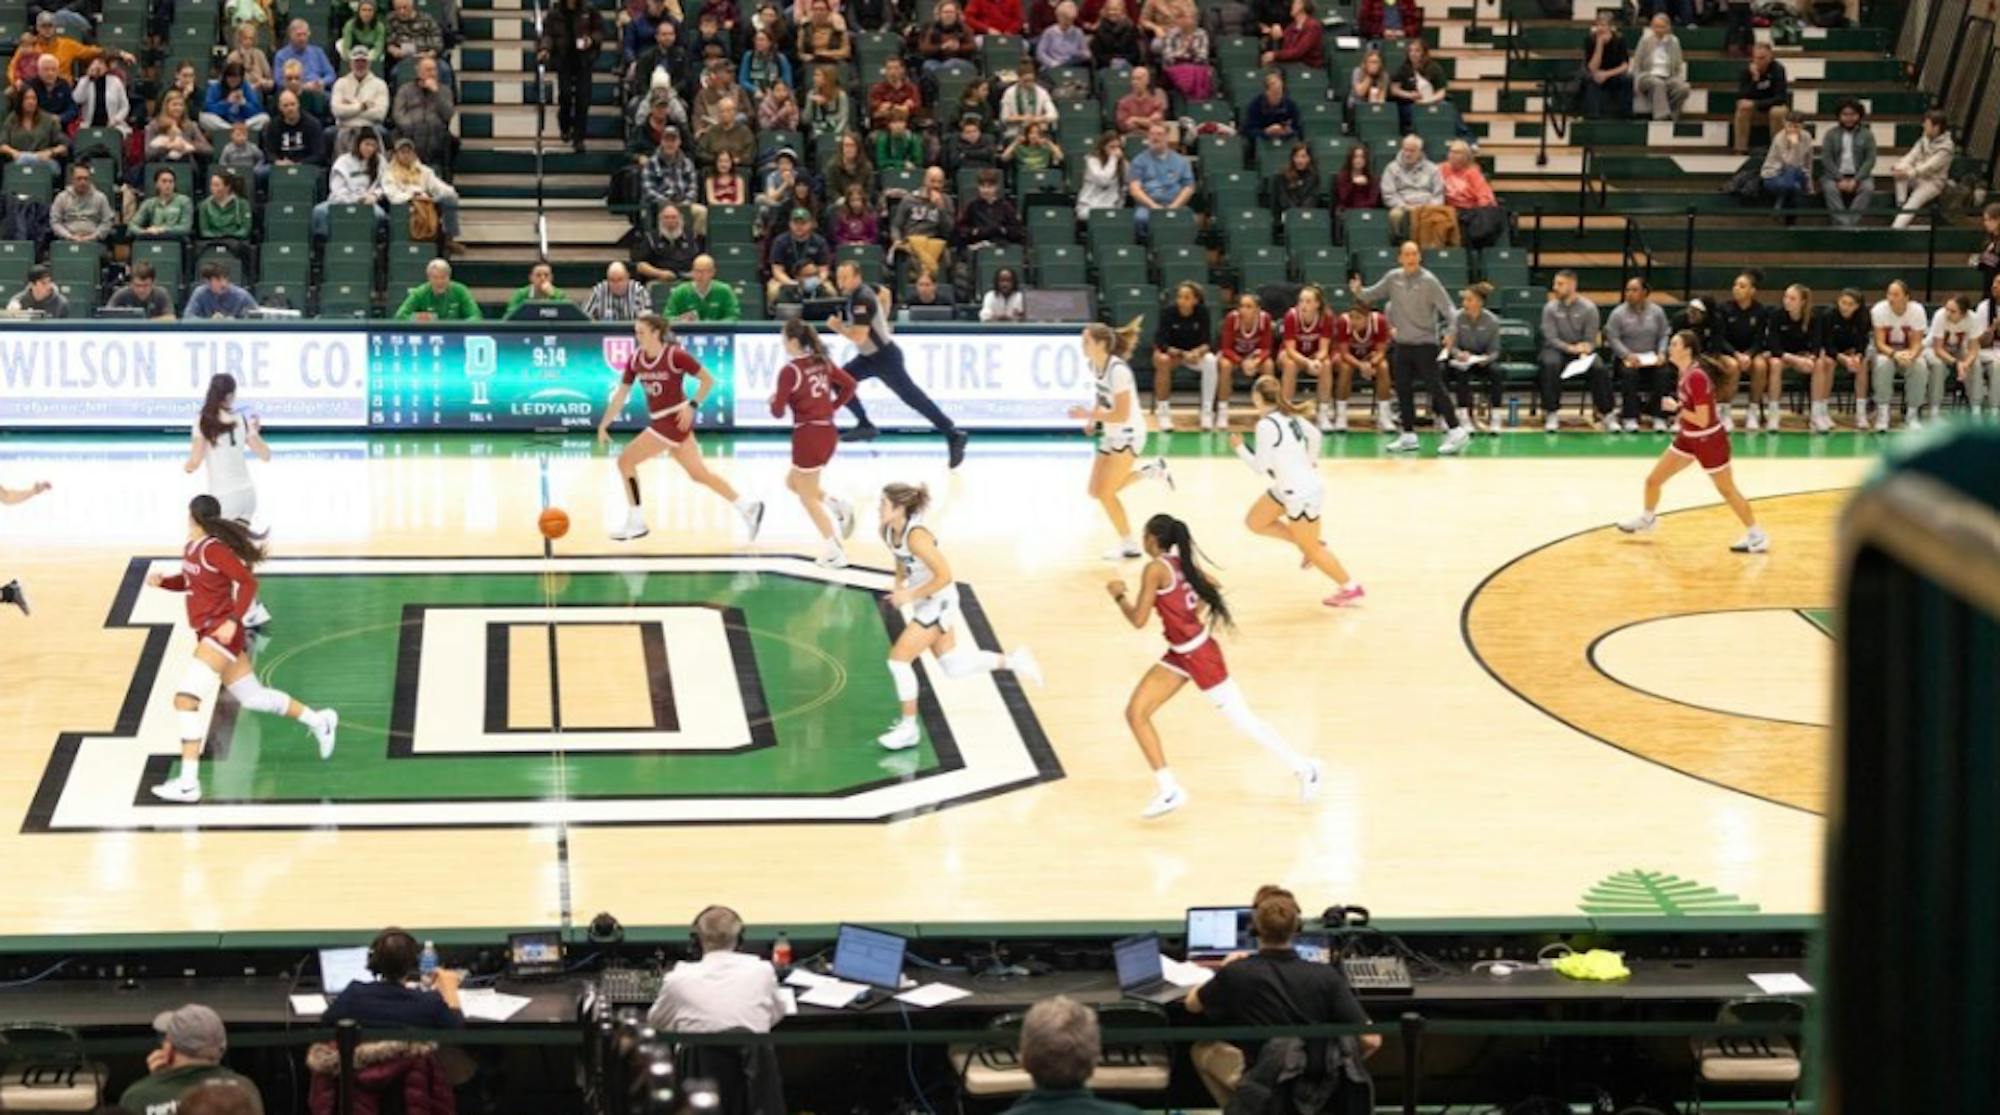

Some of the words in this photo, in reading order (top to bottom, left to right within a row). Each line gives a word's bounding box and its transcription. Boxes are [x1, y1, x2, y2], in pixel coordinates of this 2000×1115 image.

[1, 340, 156, 389] WILSON
[184, 340, 270, 389] TIRE
[299, 340, 363, 389] CO.
[532, 347, 567, 368] 9:14
[920, 343, 1003, 389] TIRE
[808, 373, 830, 398] 24
[511, 402, 592, 415] LEDYARD
